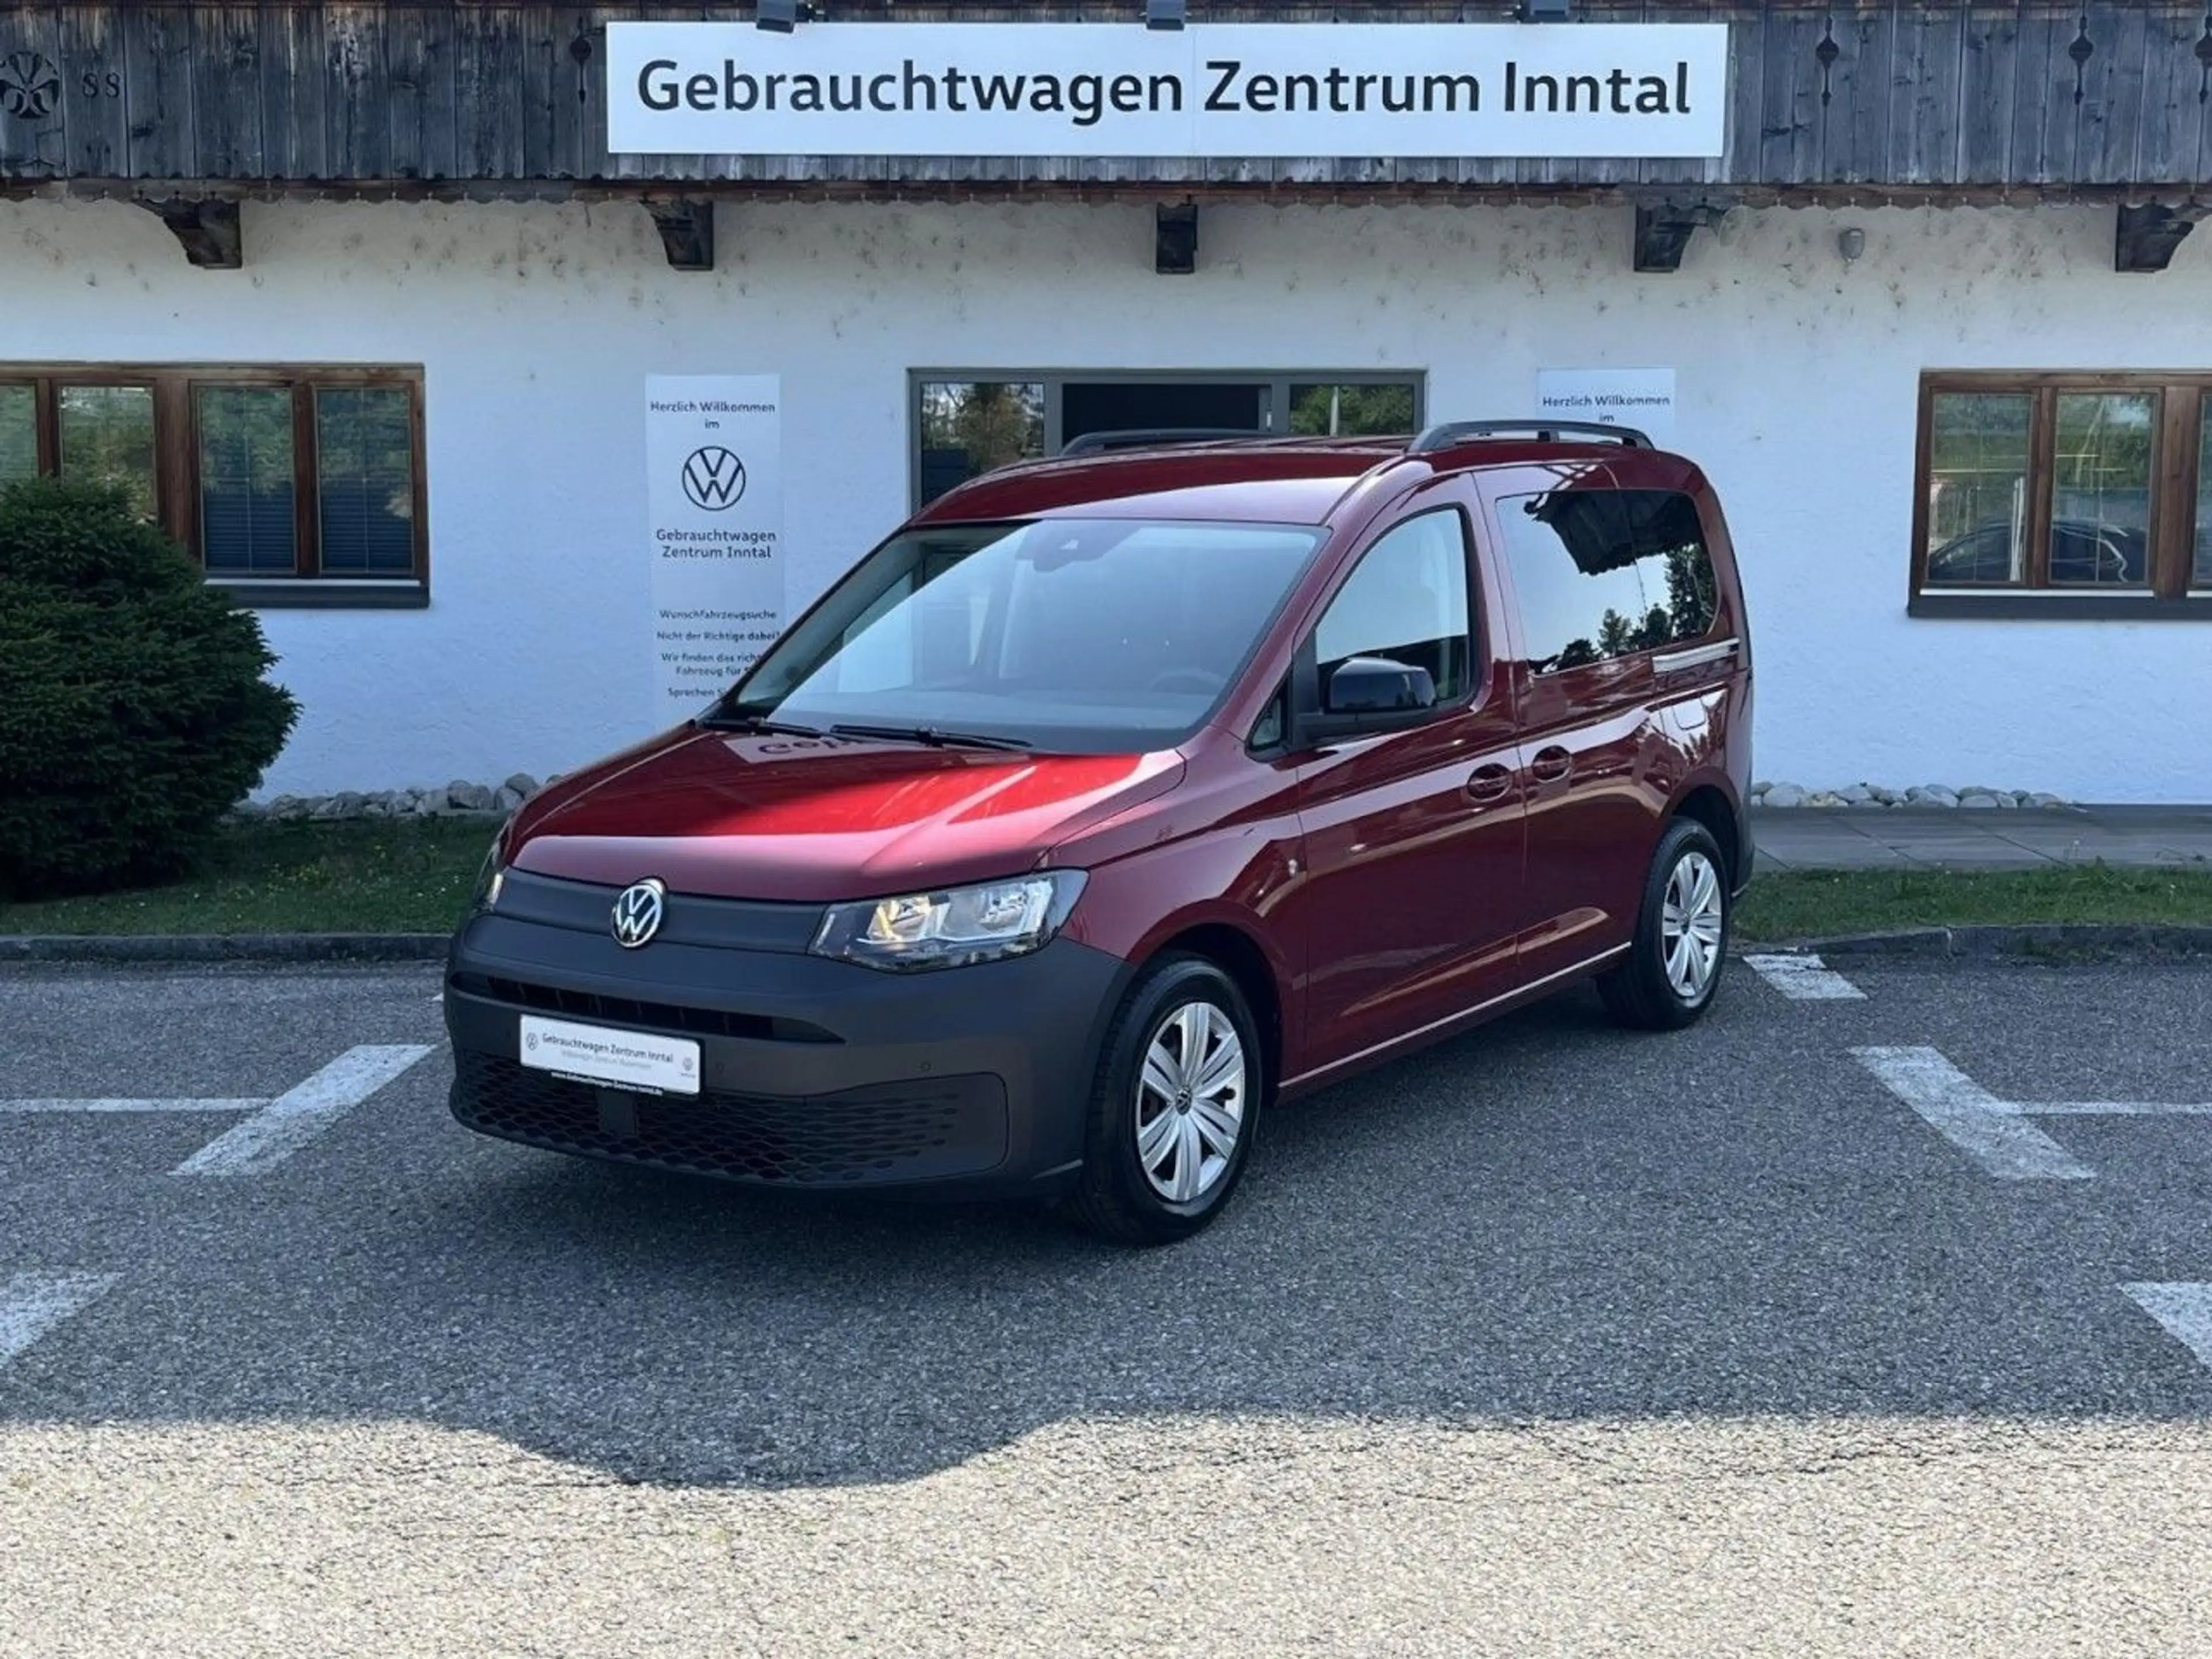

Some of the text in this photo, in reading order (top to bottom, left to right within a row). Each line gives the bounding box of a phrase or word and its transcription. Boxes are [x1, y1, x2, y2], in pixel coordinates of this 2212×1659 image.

[637, 59, 1691, 126] Gebrauchtwagen Zentrum Inntal
[650, 400, 775, 413] Herzlich Willkommen
[1542, 395, 1671, 407] Herzlich Willkommen
[1599, 412, 1615, 422] im
[704, 418, 720, 429] im
[656, 529, 777, 544] Gebrauchtwagen
[662, 546, 772, 559] Zentrum Inntal
[660, 609, 777, 620] Wunschfahrzeugsuche
[657, 631, 683, 641] Nicht
[685, 631, 701, 641] der
[542, 1032, 609, 1054] Gebrauchtwagen
[610, 1044, 646, 1058] Zentrum
